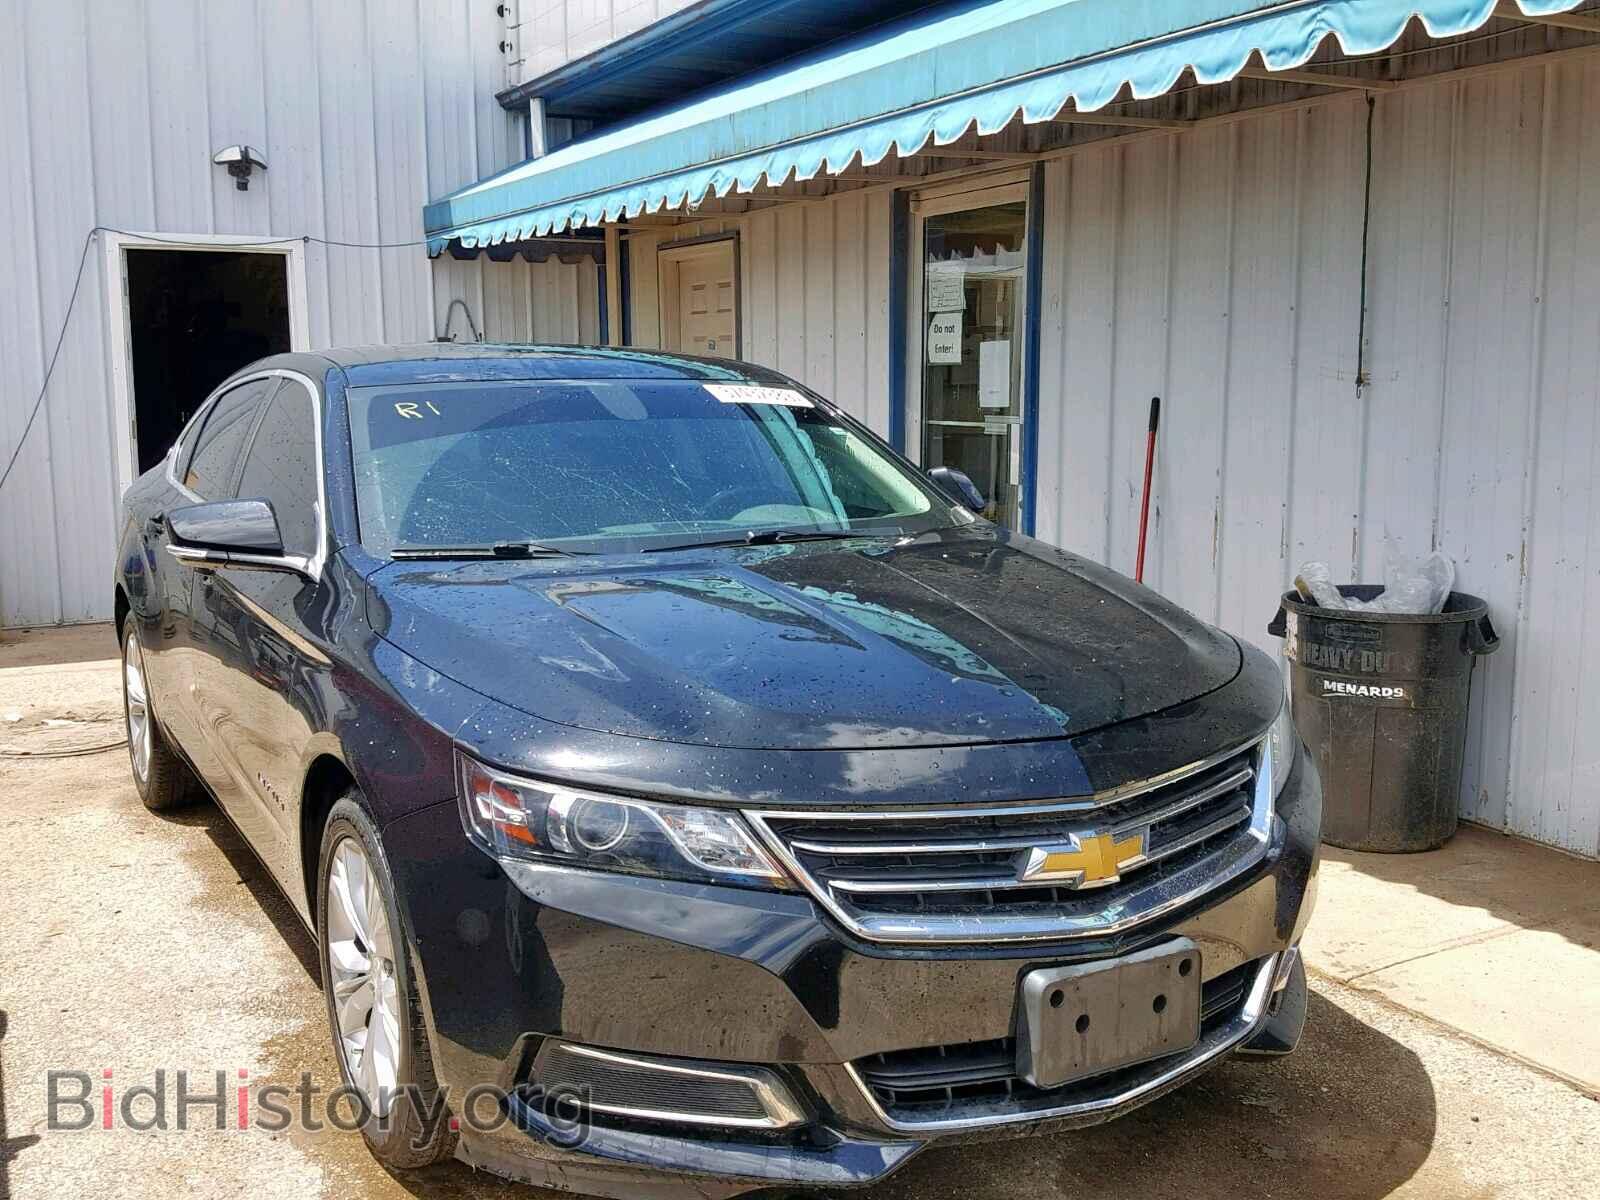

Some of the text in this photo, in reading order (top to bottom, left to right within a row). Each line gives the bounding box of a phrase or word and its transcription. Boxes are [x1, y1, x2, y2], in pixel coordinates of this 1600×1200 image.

[933, 323, 955, 334] Do not
[934, 343, 954, 354] Enter!
[1322, 679, 1404, 699] MENARDS
